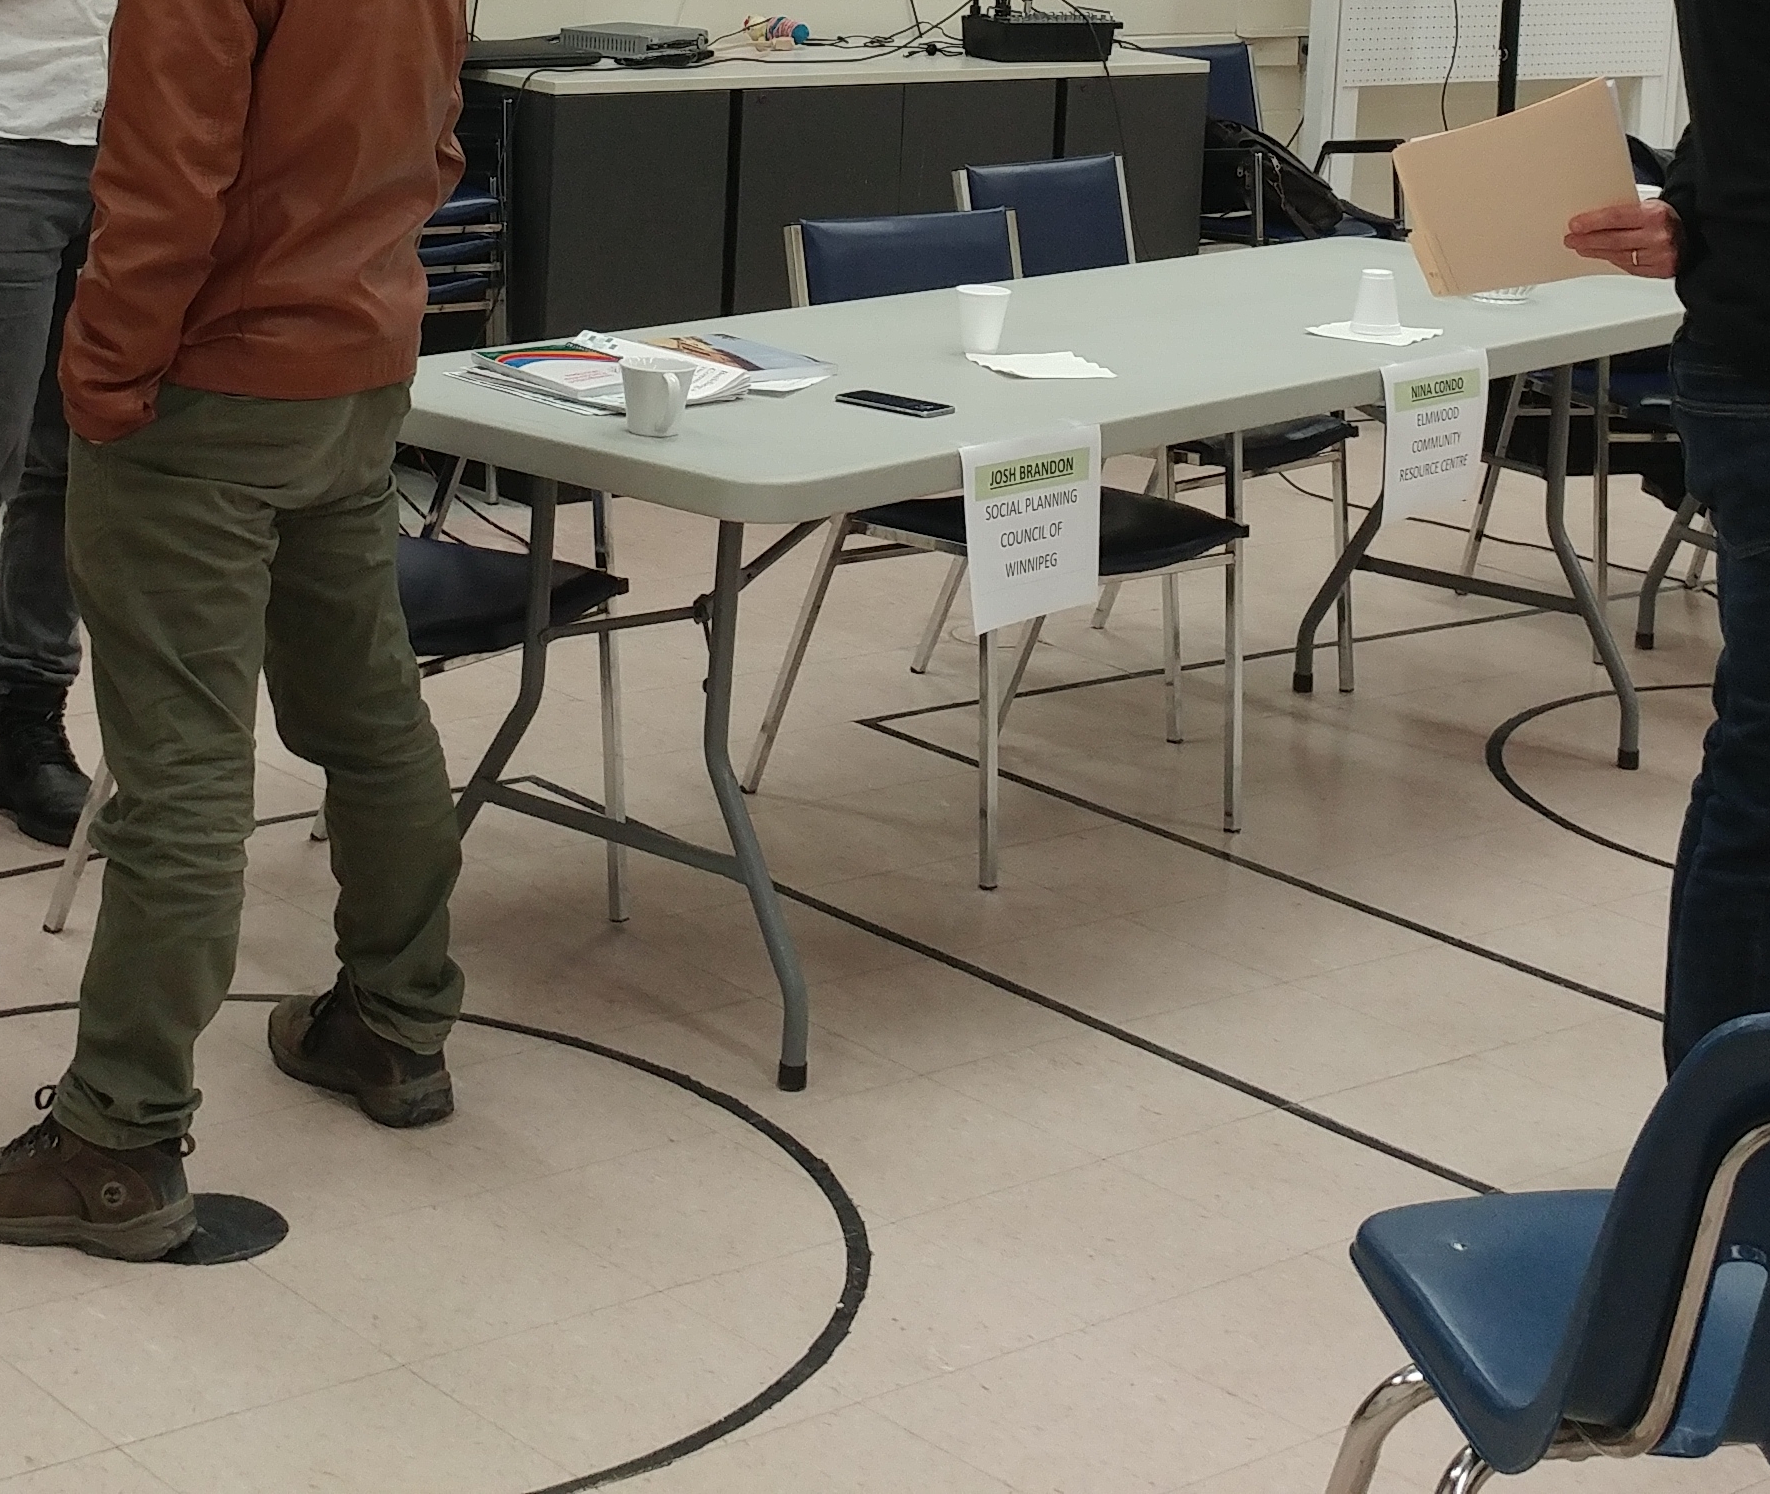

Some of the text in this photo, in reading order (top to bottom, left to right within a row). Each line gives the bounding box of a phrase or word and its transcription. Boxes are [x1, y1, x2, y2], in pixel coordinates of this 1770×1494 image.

[1411, 377, 1465, 400] NINA CONDO
[1417, 406, 1460, 427] ELMWOOD
[1412, 432, 1461, 454] COMMUNITY
[989, 456, 1074, 486] JOSH BRANDON
[1399, 453, 1469, 482] RESOURCE CENTRE
[985, 488, 1078, 521] SOCIAL PLANNING
[1000, 521, 1063, 548] COUNCIL OF
[1005, 552, 1058, 578] WINNIPEG
